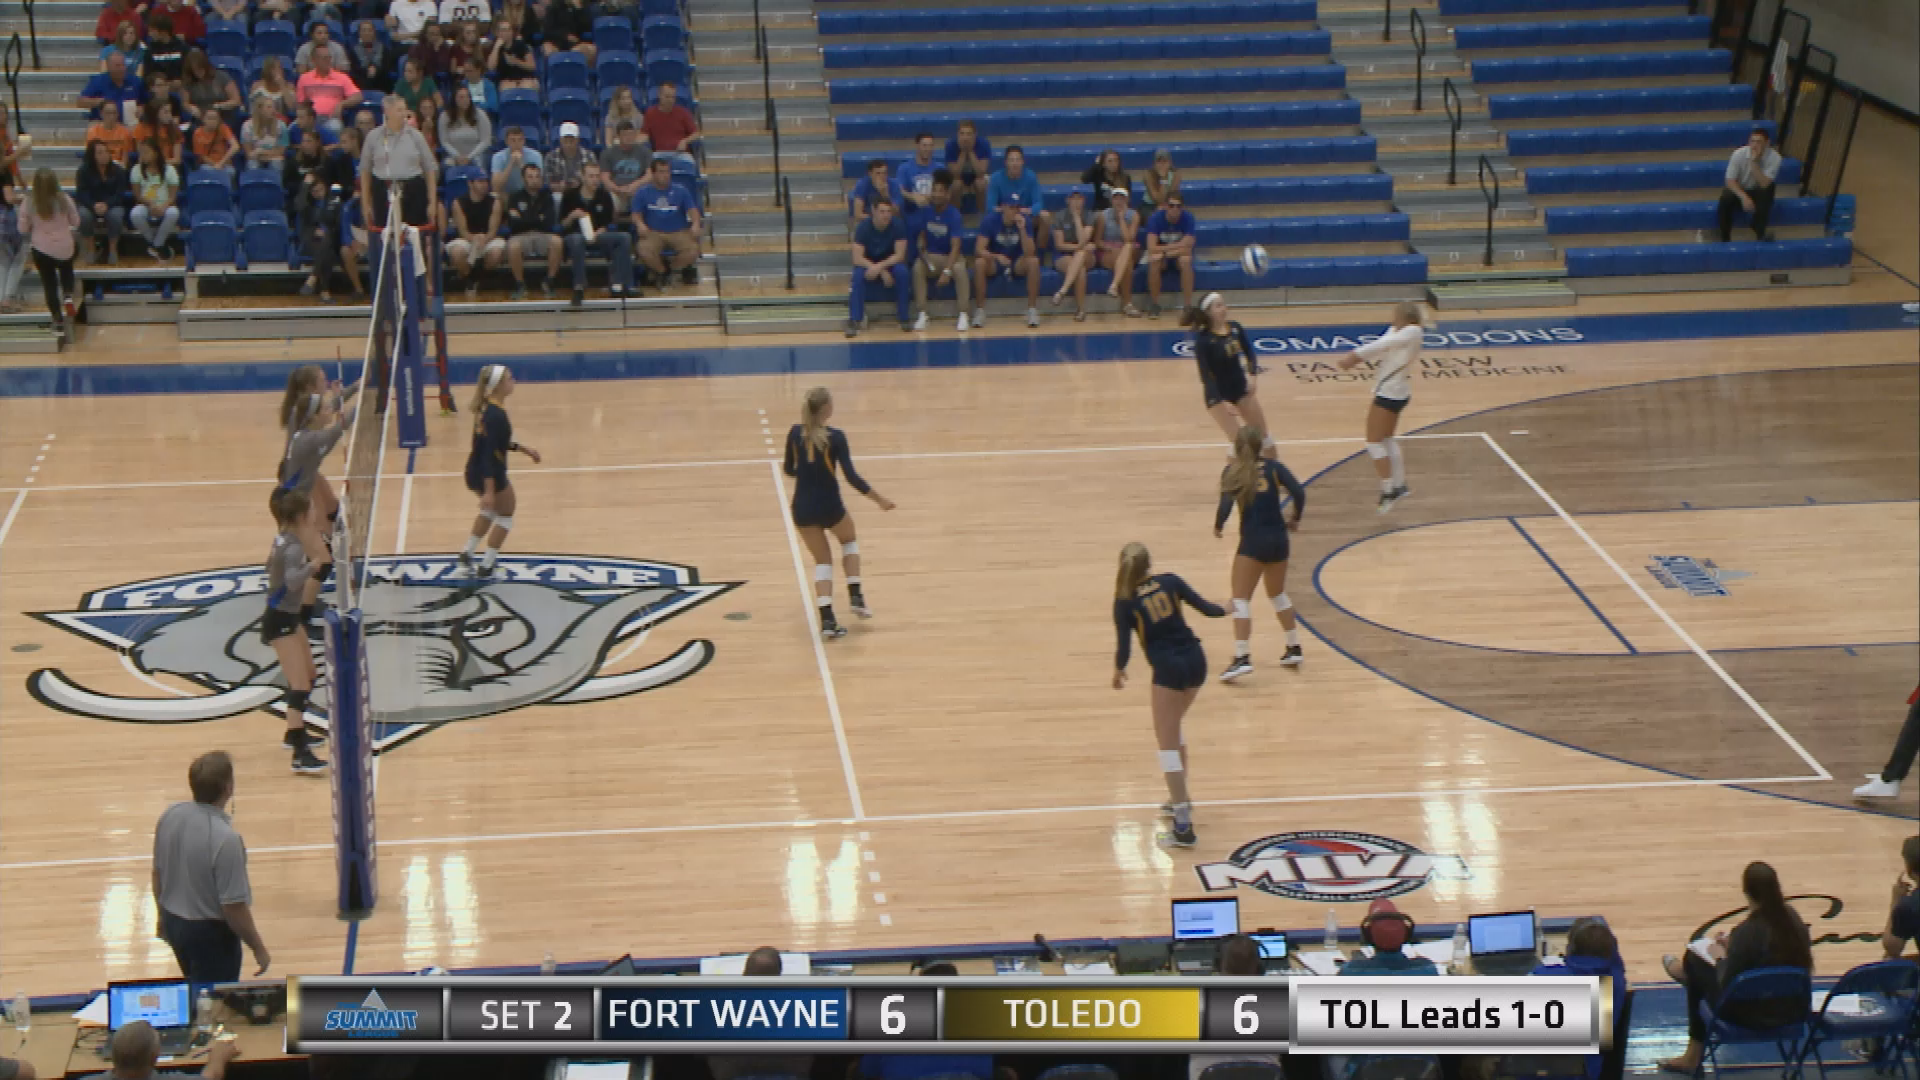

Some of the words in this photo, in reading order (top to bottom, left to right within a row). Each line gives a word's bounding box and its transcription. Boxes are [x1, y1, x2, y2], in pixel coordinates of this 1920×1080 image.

[1171, 326, 1584, 357] @OMASODONS
[1287, 355, 1493, 373] PAKIEW
[1143, 591, 1174, 624] 10
[1195, 852, 1475, 893] MIVA
